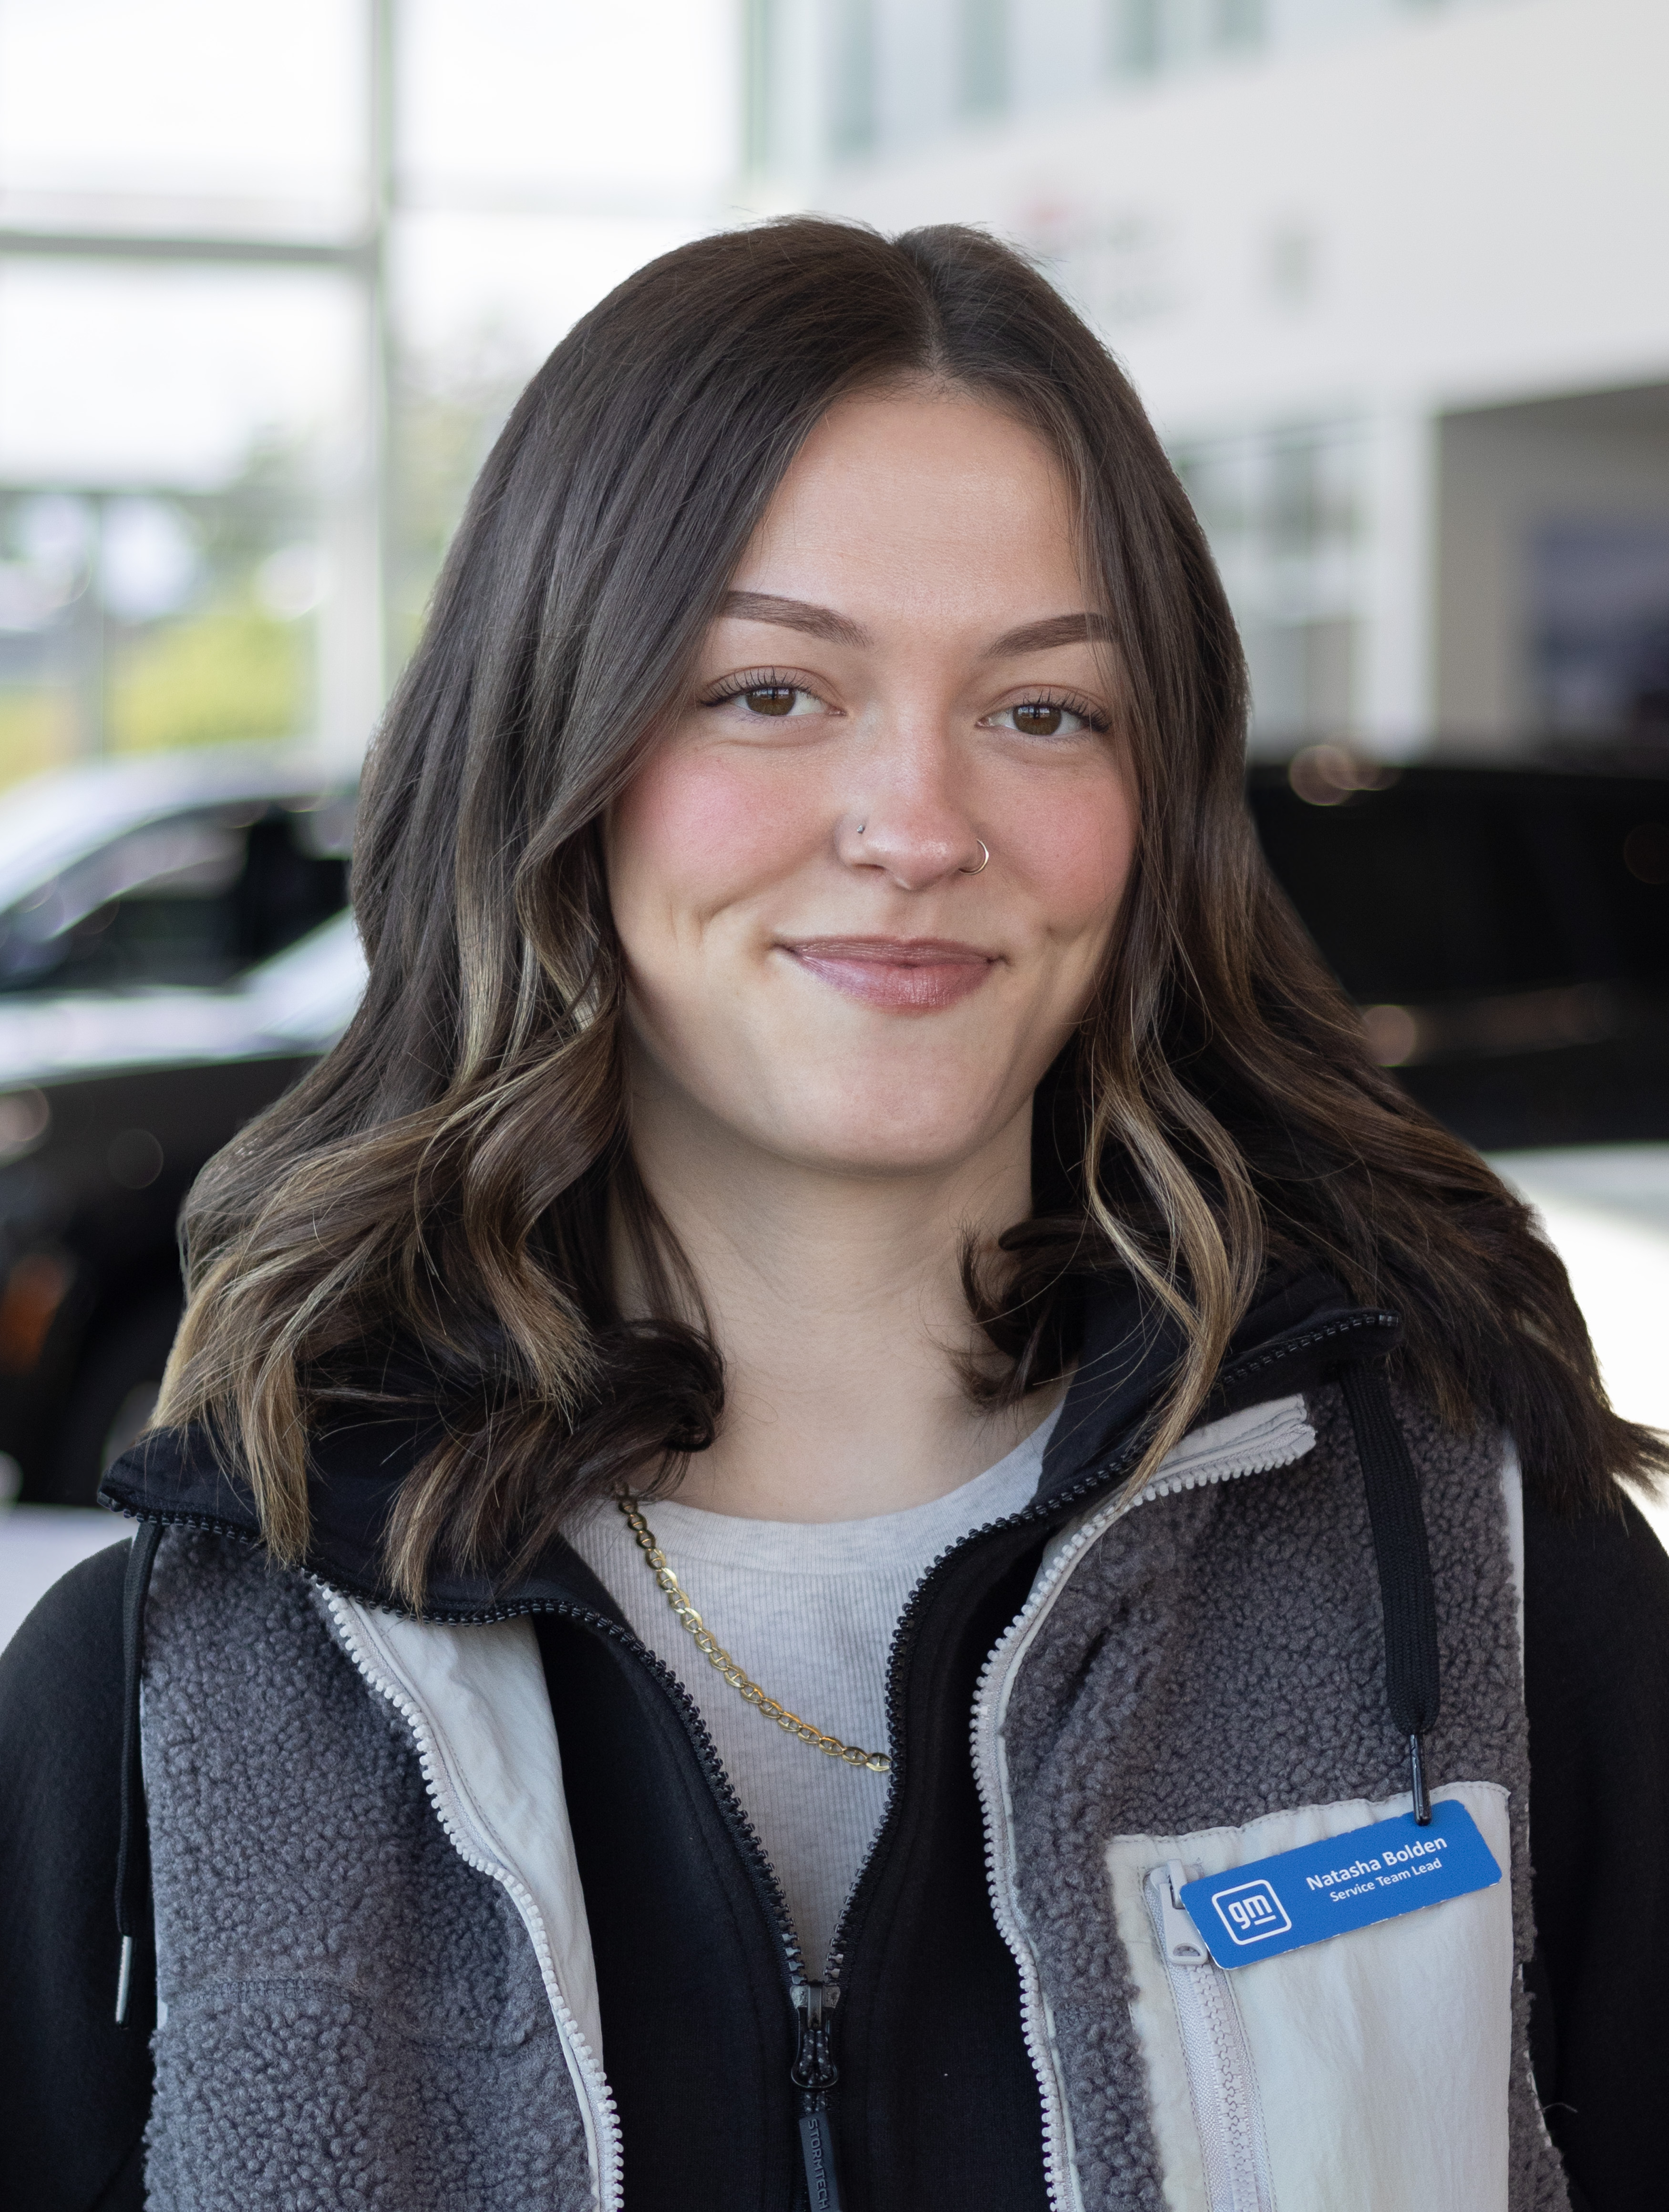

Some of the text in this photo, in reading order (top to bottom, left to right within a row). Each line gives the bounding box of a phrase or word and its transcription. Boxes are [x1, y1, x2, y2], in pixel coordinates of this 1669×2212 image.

[1306, 1837, 1448, 1891] Natasha Bolden
[1329, 1857, 1442, 1902] Service Team Lead
[1228, 1895, 1274, 1930] gm
[808, 2118, 829, 2211] STORMTECH
